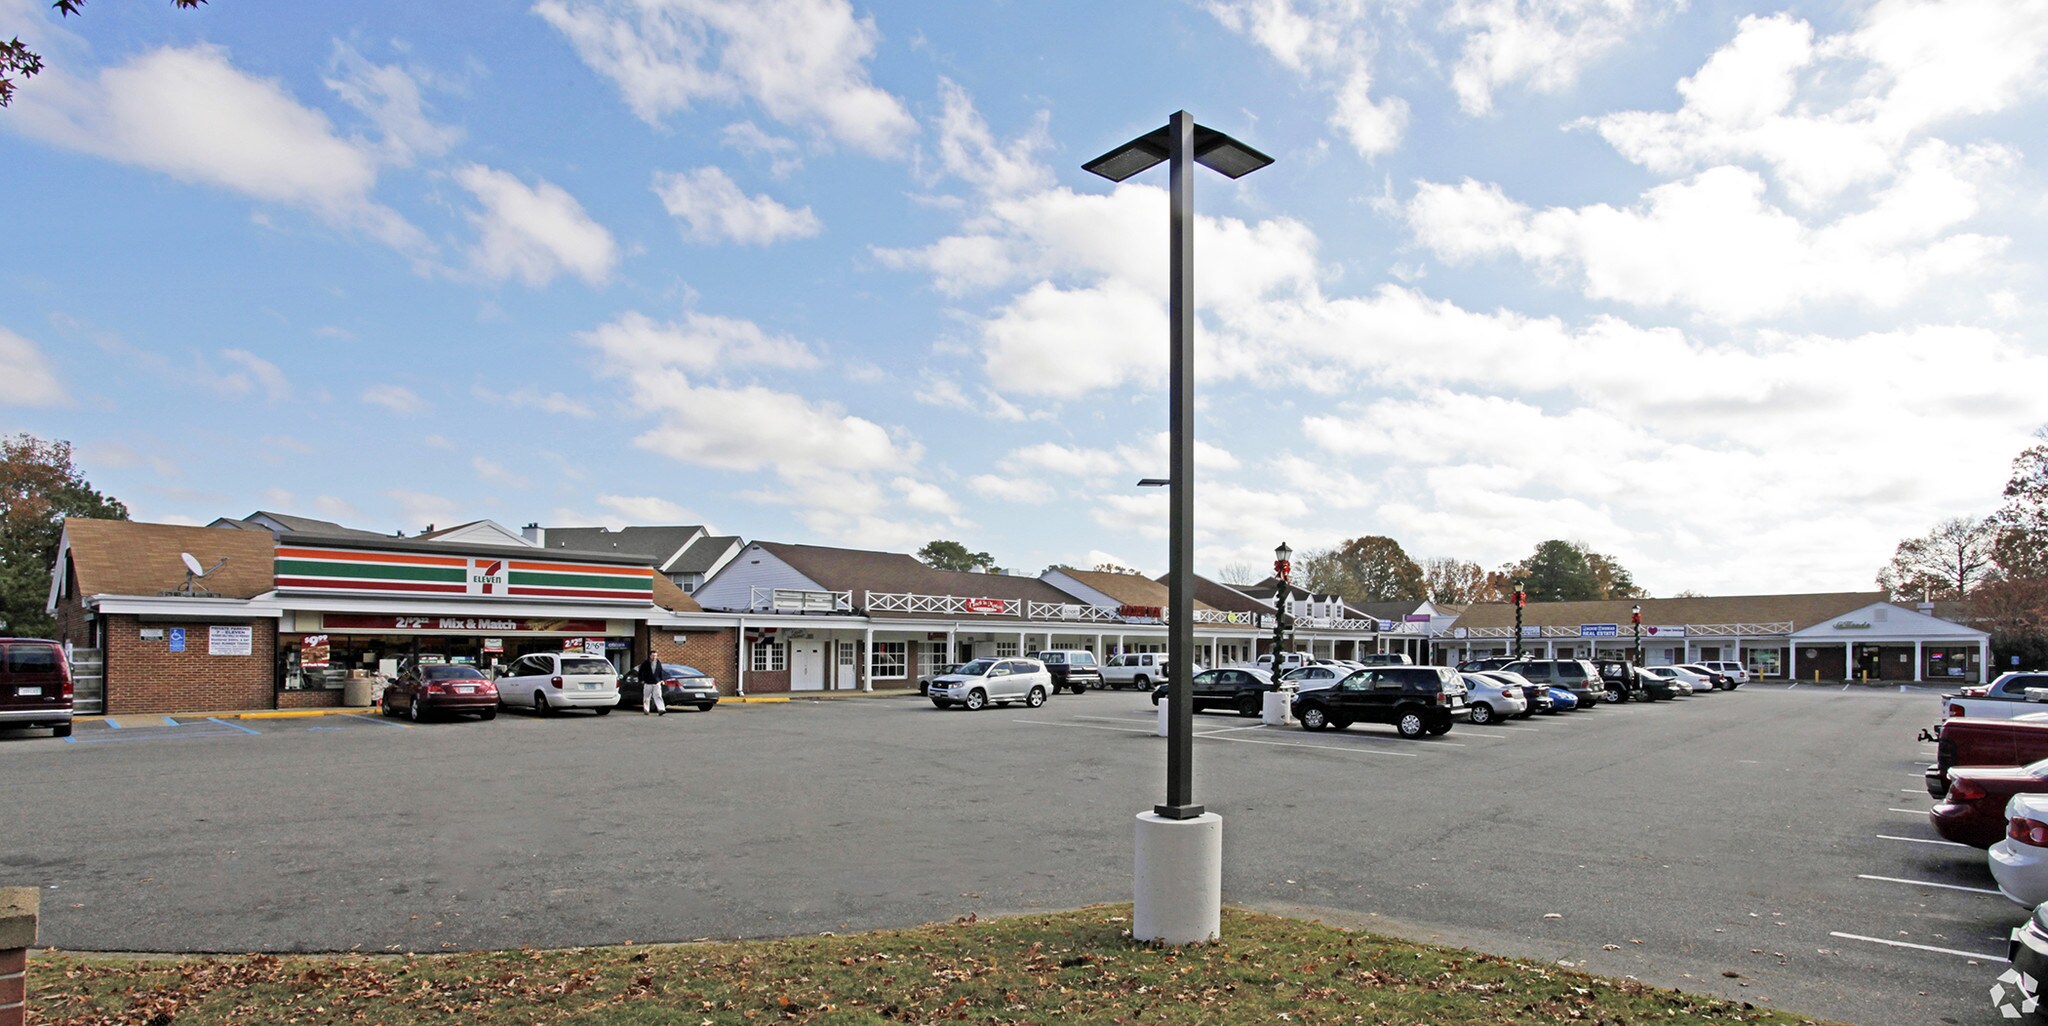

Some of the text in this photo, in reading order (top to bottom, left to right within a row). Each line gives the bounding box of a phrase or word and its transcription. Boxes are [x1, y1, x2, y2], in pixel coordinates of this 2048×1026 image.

[482, 560, 502, 594] 7
[439, 618, 464, 629] Mix
[465, 618, 477, 629] &
[478, 618, 517, 630] Match
